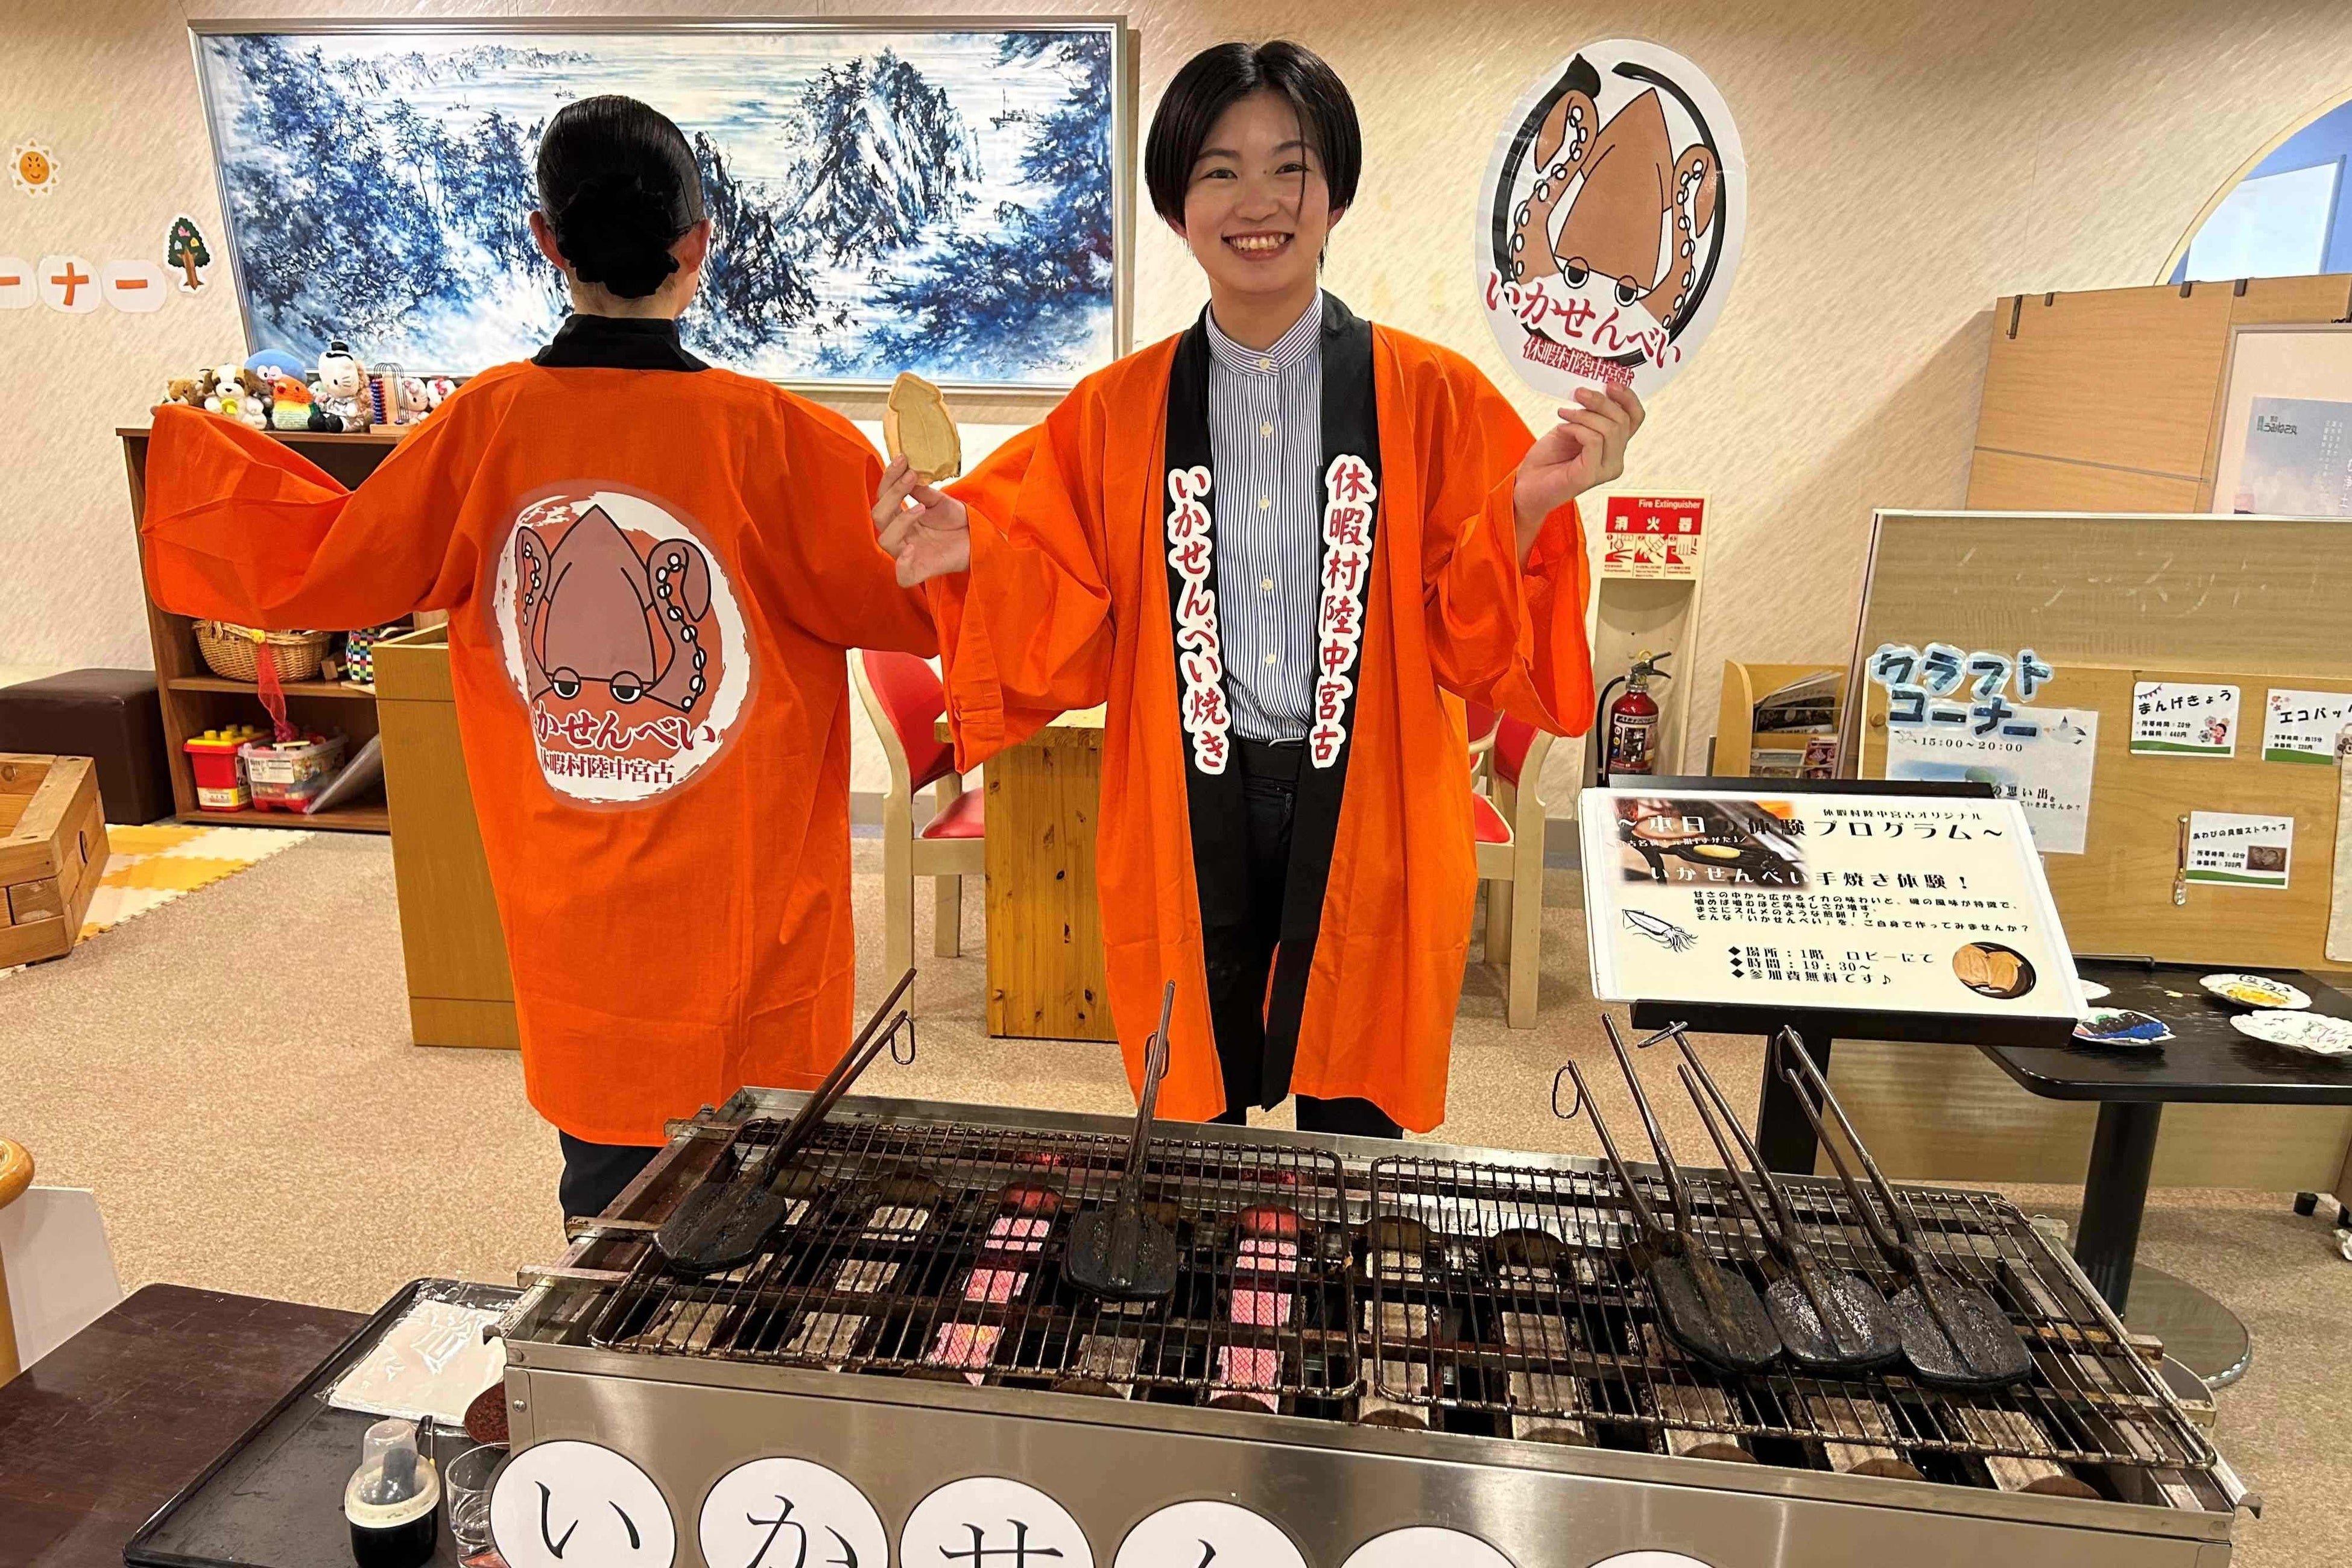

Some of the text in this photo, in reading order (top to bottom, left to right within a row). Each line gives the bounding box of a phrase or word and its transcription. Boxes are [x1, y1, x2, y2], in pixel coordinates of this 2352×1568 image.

[1487, 271, 1681, 368] いかせんべい
[1523, 335, 1634, 389] 休暇村陸中宮古
[1639, 499, 1701, 510] Fire Extinguisher
[1175, 473, 1226, 767] いかせんべい焼き
[1314, 462, 1370, 761] 休暇村陸中宮古
[1879, 651, 2049, 697] クラフト
[1889, 689, 2037, 737] コーナー
[2139, 689, 2231, 715] まんげきょう
[2280, 704, 2352, 724] エコバッ
[1823, 809, 1982, 821] 休暇村陸中宮古オリジナル
[1651, 866, 1968, 890] いかせんべい手焼き体験！
